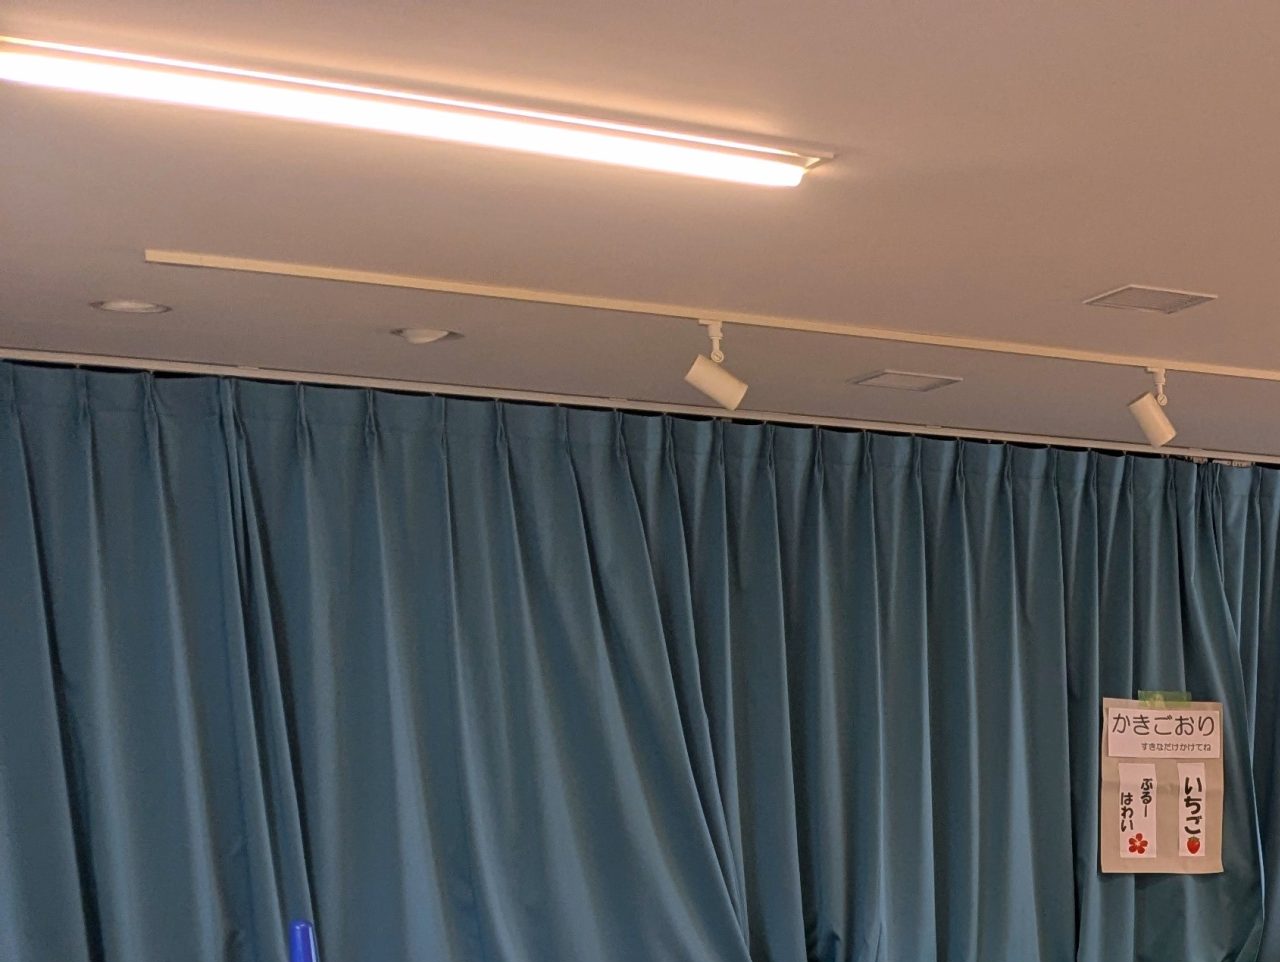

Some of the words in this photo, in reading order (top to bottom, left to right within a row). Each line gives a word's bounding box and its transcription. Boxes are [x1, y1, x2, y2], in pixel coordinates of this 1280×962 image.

[1112, 713, 1215, 737] かきごおり
[1141, 742, 1212, 752] すきなだけかけてね
[1120, 791, 1134, 832] はわい
[1183, 776, 1203, 835] いちご
